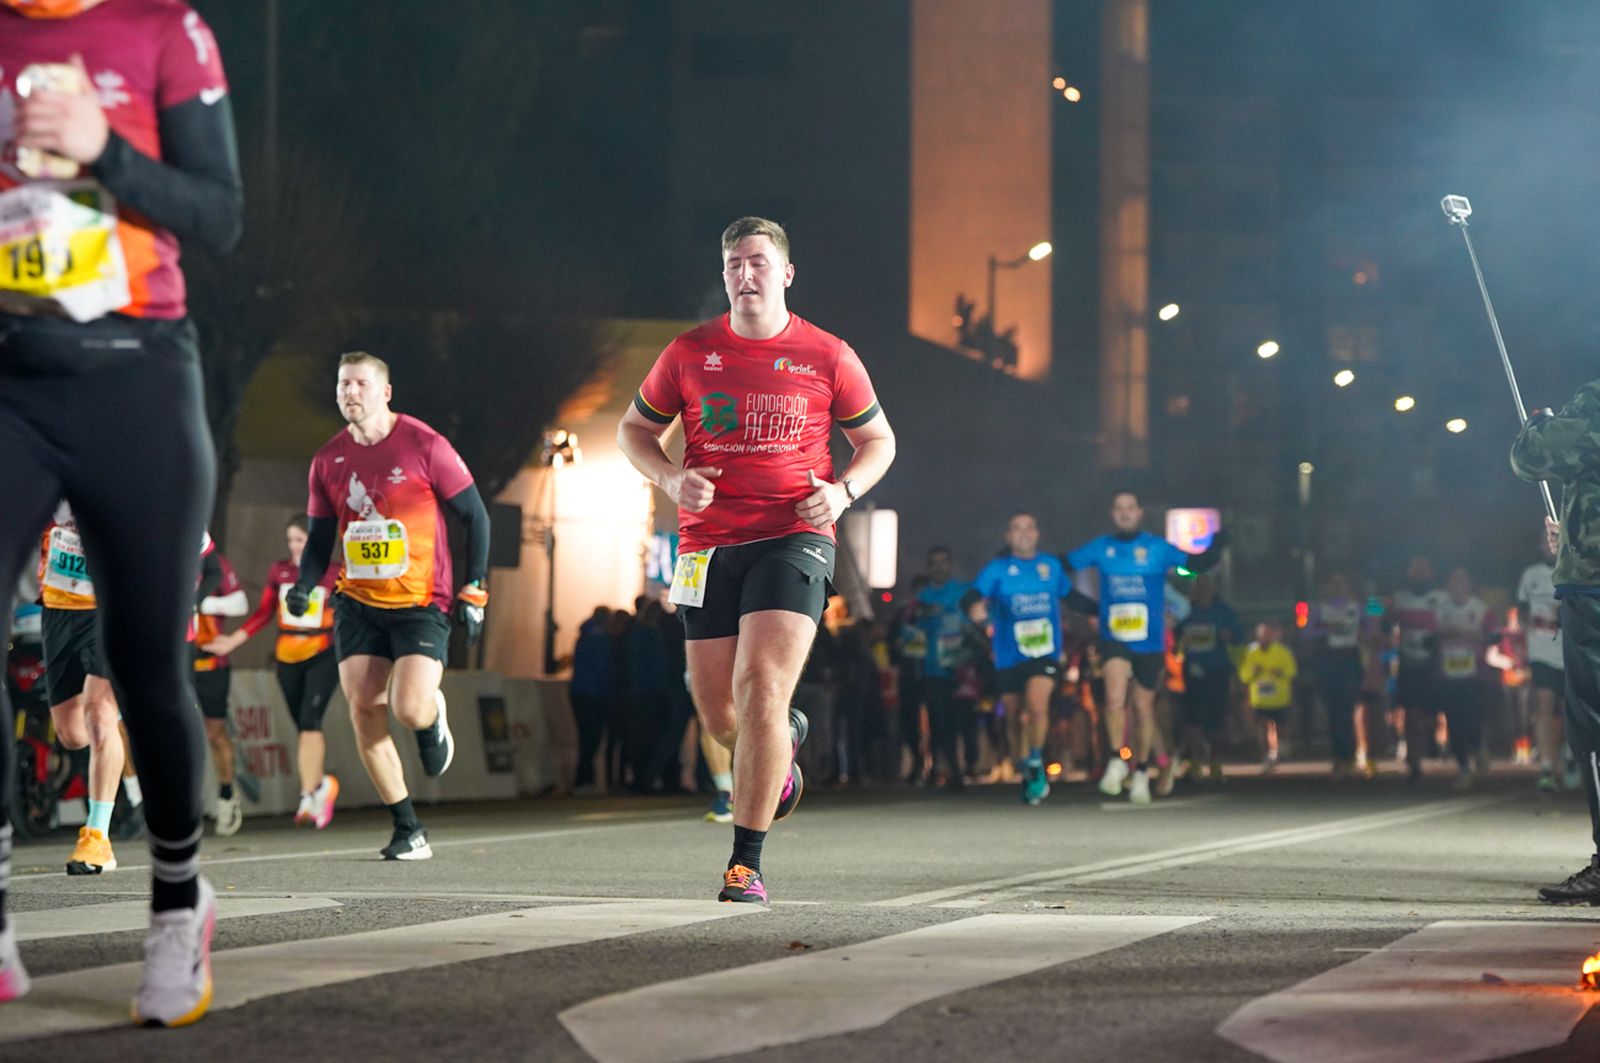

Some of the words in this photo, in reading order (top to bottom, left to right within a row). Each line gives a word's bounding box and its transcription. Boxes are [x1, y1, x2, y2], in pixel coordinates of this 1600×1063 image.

[746, 392, 809, 417] FUNDACIÓN
[361, 542, 389, 559] 537
[58, 551, 88, 574] 912
